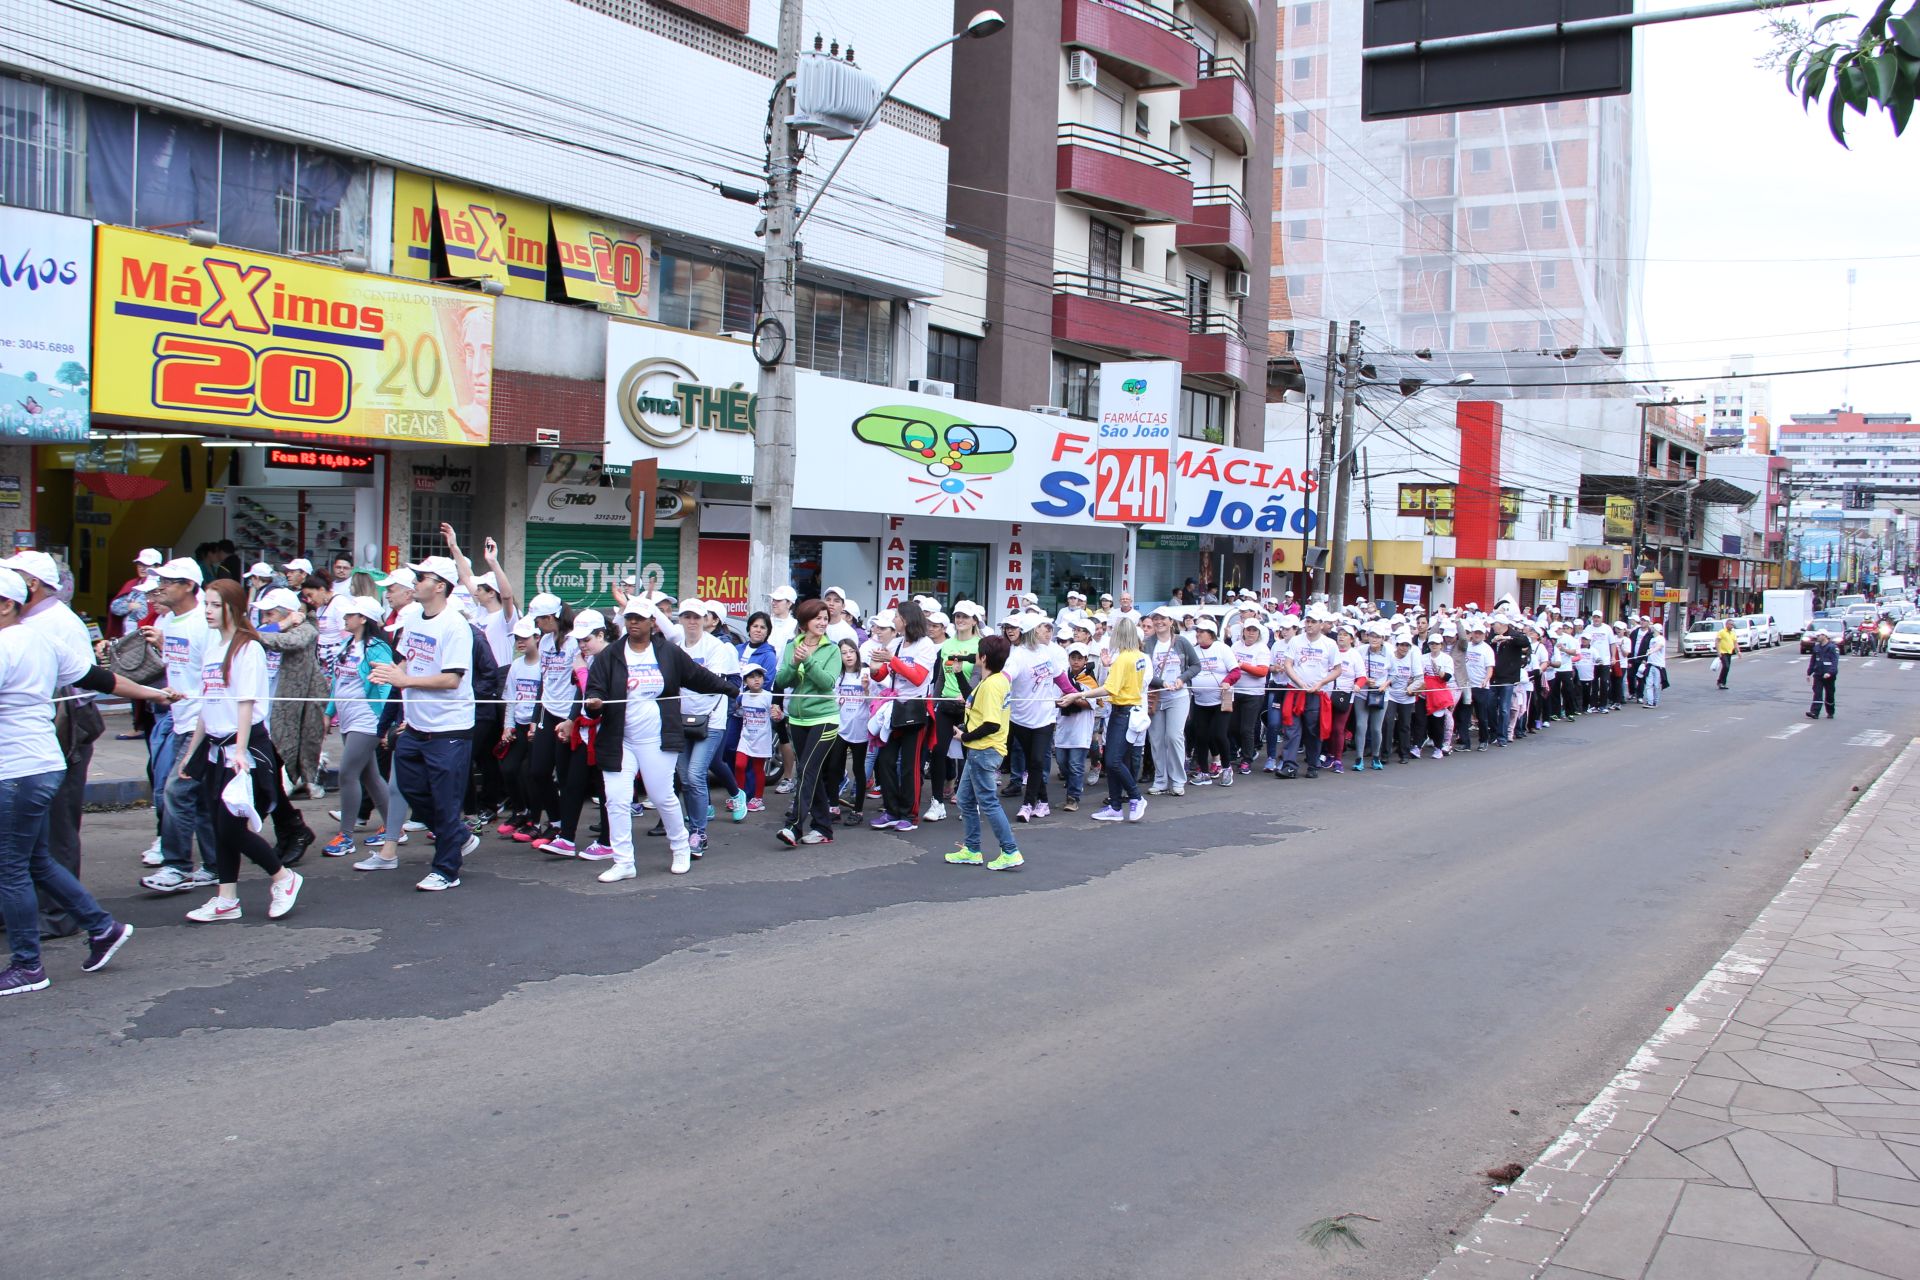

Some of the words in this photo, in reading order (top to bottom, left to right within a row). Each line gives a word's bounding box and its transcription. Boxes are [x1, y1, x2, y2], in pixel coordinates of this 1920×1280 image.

[19, 339, 75, 354] 3045.6898
[376, 330, 442, 398] 20
[151, 332, 352, 424] 20
[637, 390, 682, 417] ÓTICA
[673, 381, 759, 435] THÉ
[384, 412, 439, 435] REAIS
[1103, 411, 1168, 424] FARMÁCIAS
[1100, 423, 1128, 438] São
[1132, 423, 1170, 438] João
[300, 452, 317, 465] R$
[451, 481, 471, 493] 677
[1096, 454, 1166, 518] 24h
[563, 493, 597, 505] THÉO
[655, 495, 678, 509] HÉO
[1187, 489, 1319, 534] João
[553, 572, 584, 588] ÓTICA
